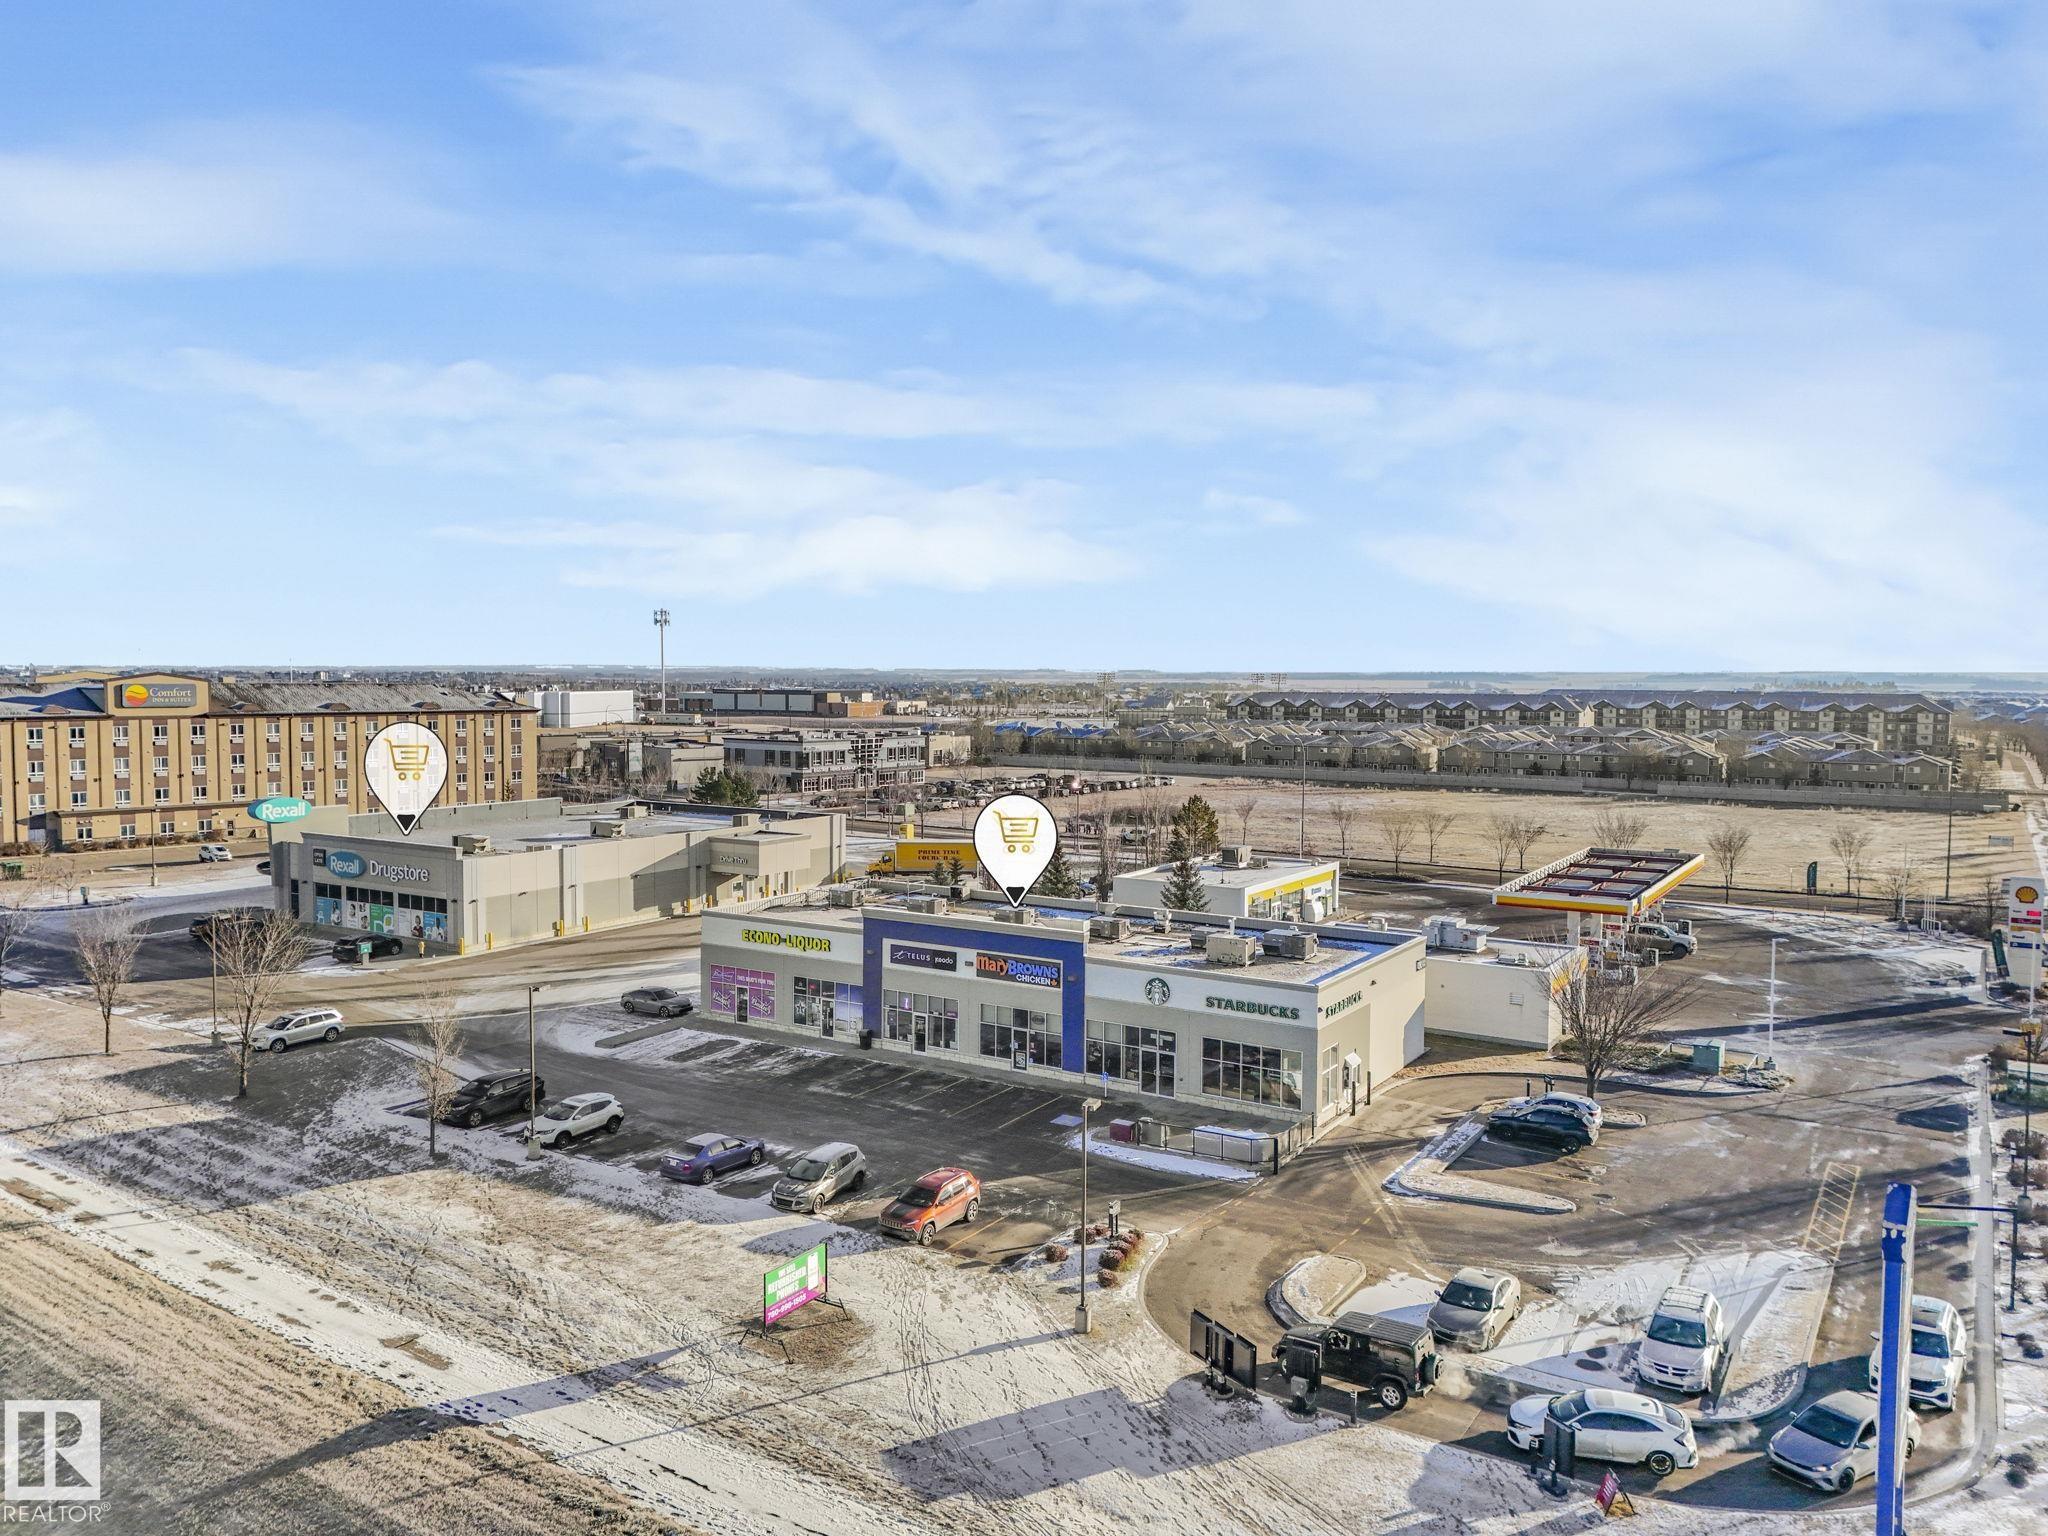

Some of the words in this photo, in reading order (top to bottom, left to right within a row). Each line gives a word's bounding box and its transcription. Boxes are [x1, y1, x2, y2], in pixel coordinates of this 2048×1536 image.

[149, 687, 192, 697] Comfort
[262, 801, 306, 820] Rexall
[330, 855, 359, 874] Rexall
[369, 860, 429, 882] Drugstore
[906, 952, 931, 962] TELUS
[1016, 973, 1051, 986] CHICKEN
[1205, 996, 1300, 1020] STARBUCKS
